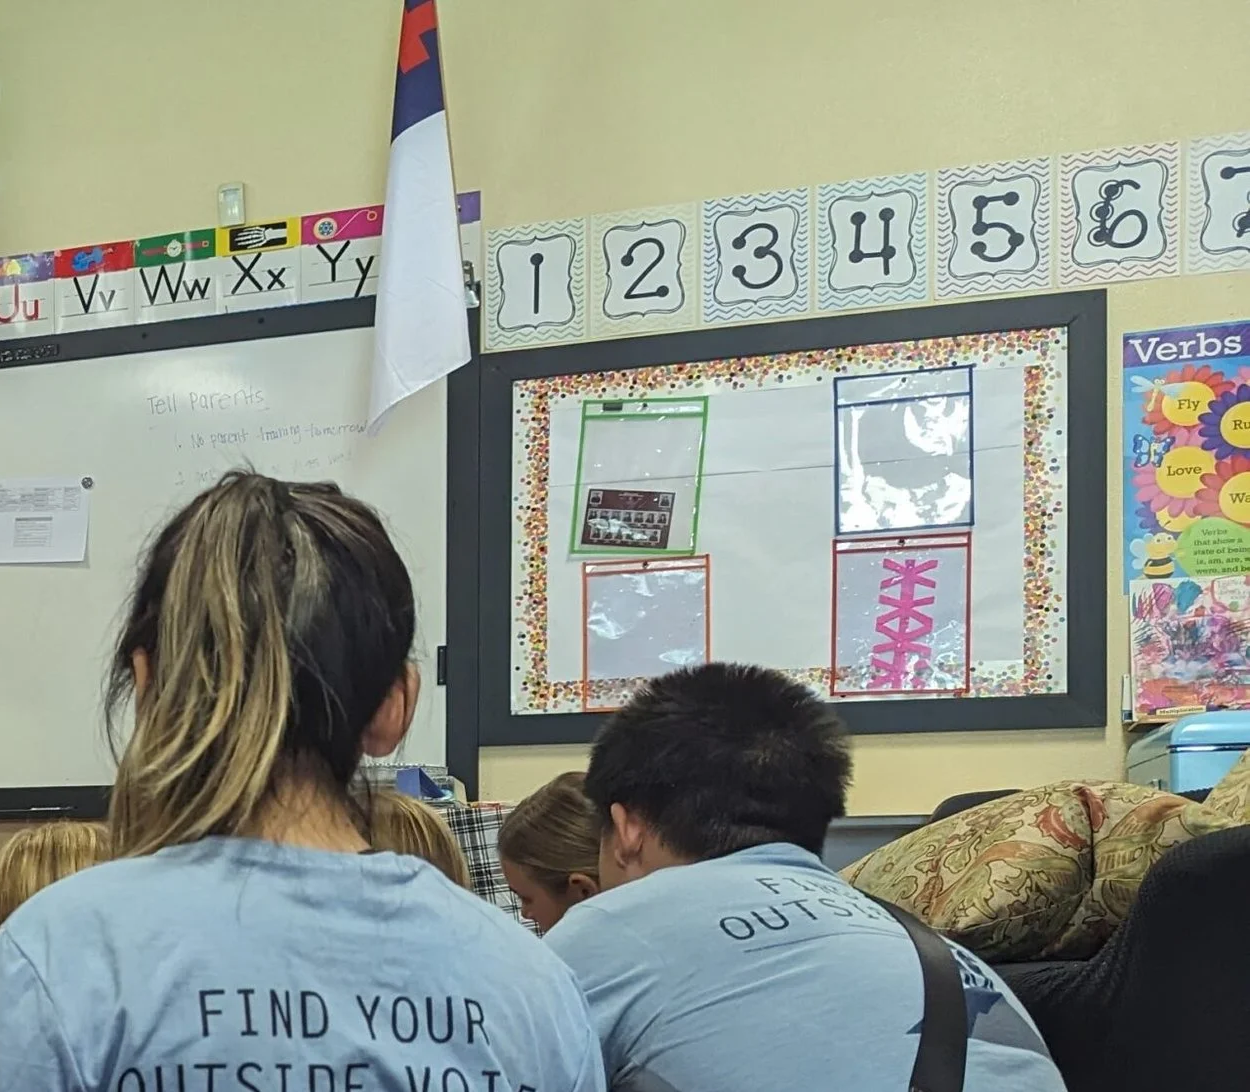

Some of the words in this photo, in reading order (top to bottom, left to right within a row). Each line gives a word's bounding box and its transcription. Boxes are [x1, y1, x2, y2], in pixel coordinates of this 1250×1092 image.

[530, 253, 544, 314] 1
[621, 237, 669, 299] 2
[731, 222, 783, 289] 3
[849, 207, 896, 275] 4
[970, 191, 1024, 262] 5
[1087, 179, 1148, 248] 6
[73, 275, 116, 313] Vv
[139, 262, 210, 305] Ww
[231, 253, 286, 295] Xx
[316, 241, 374, 297] Yy
[1128, 333, 1242, 363] Verbs
[148, 393, 177, 415] Tell
[189, 388, 264, 411] Parents
[1178, 399, 1200, 411] Fly
[1233, 420, 1250, 430] Ru
[1167, 466, 1202, 476] Love
[1229, 493, 1250, 504] Wa
[198, 989, 329, 1038] FIND
[356, 994, 490, 1046] YOUR
